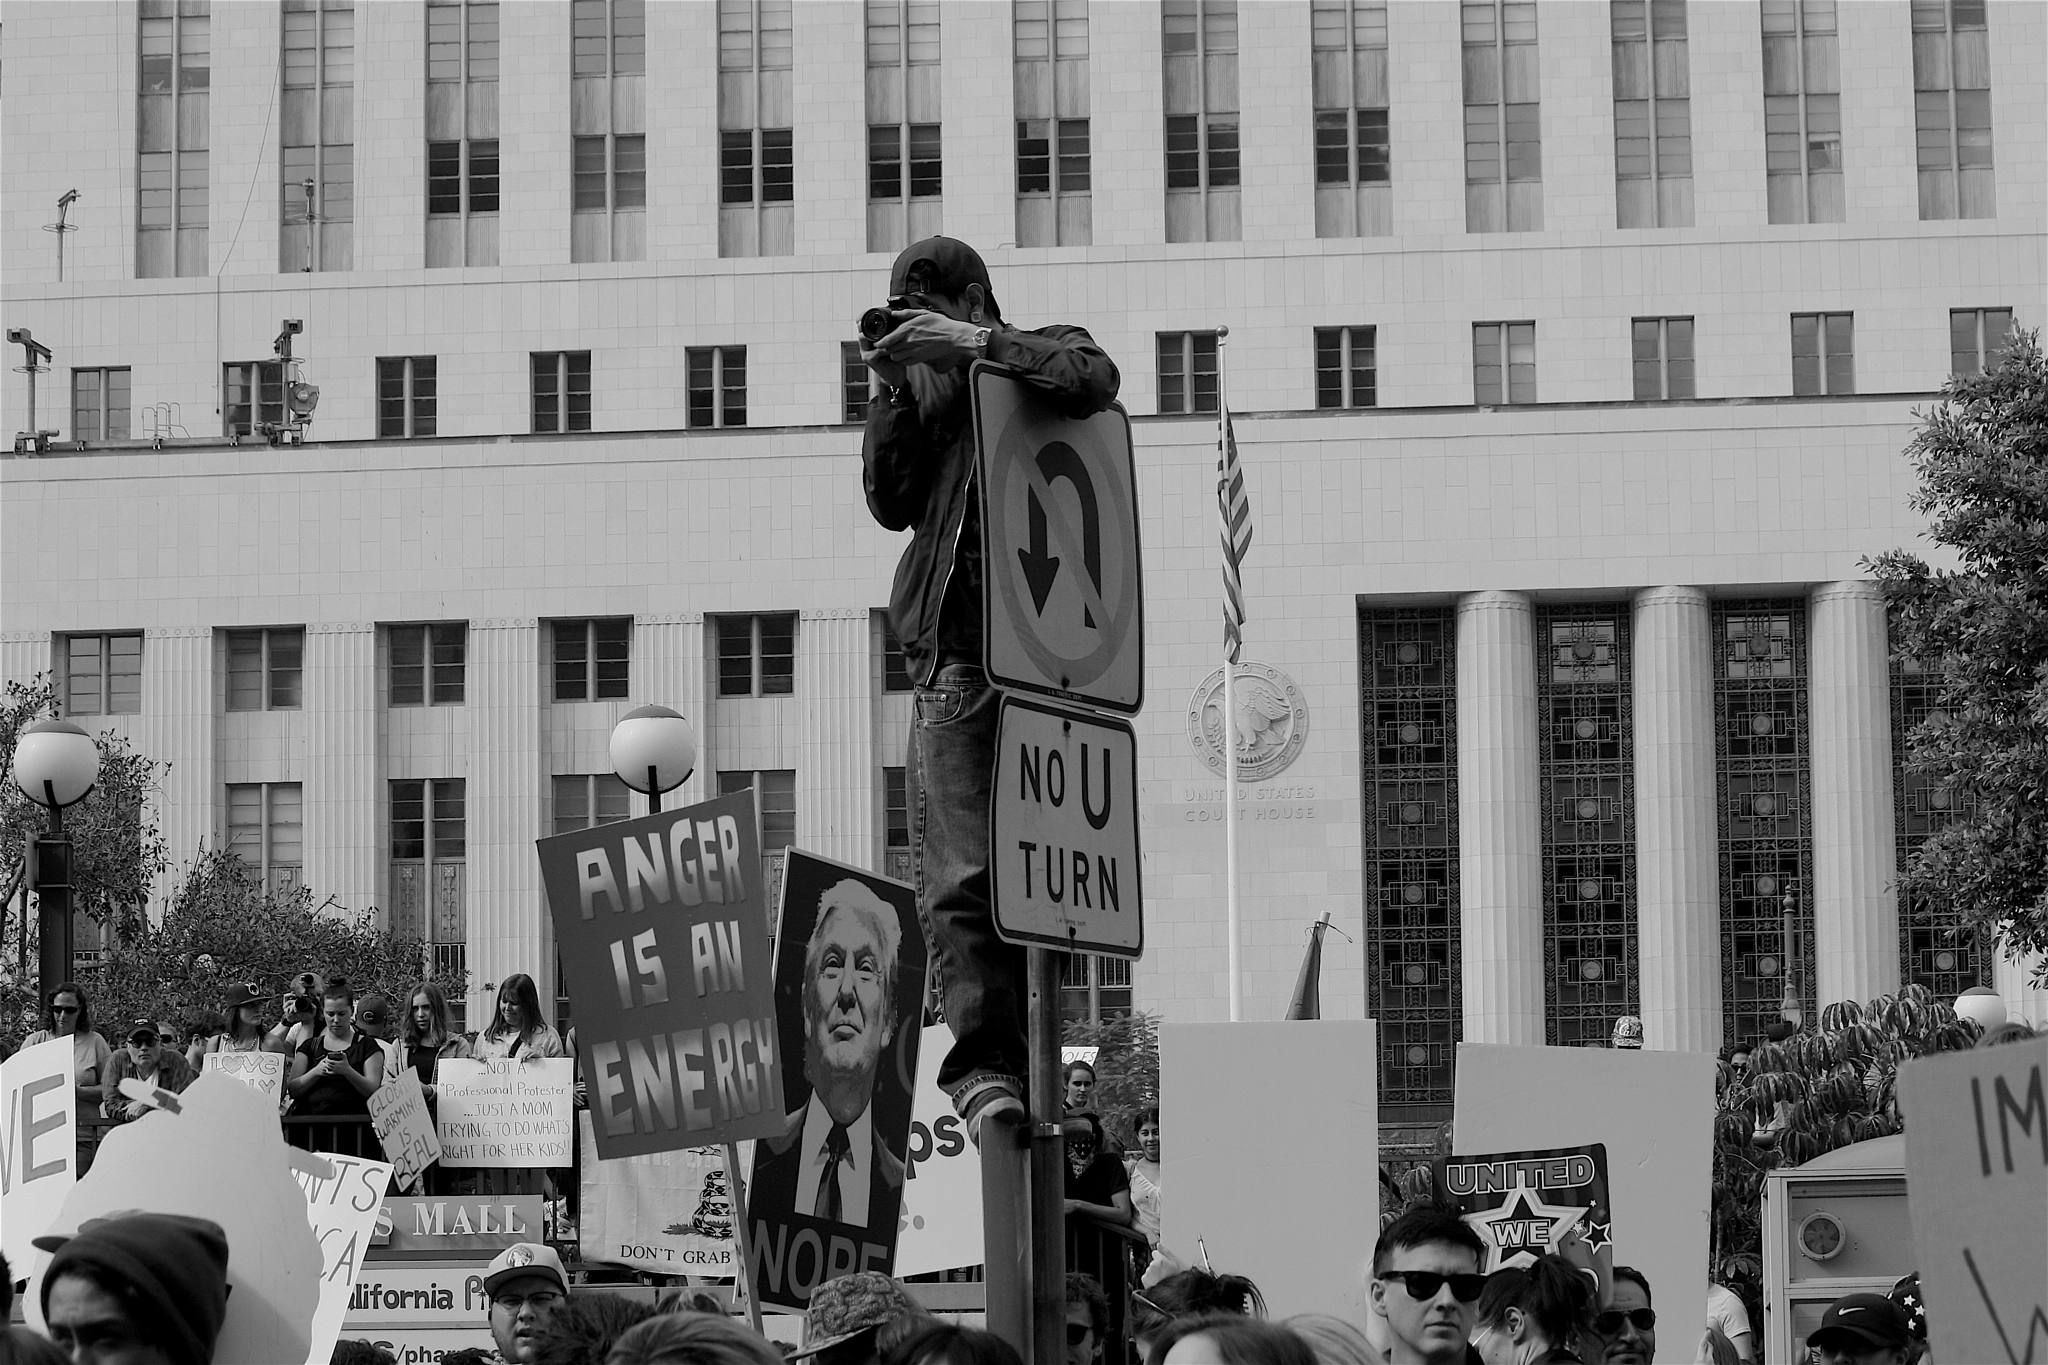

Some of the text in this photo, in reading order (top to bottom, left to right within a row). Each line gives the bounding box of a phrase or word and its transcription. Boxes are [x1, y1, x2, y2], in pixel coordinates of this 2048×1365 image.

[1021, 743, 1111, 830] NO U
[1184, 787, 1315, 801] UNITD STATES
[1184, 807, 1315, 822] COUT HOUSE
[576, 815, 747, 921] ANGER
[1019, 841, 1119, 912] TURN
[609, 920, 746, 1011] IS AN
[517, 1061, 527, 1075] A
[591, 1018, 775, 1138] ENERGY
[371, 1079, 416, 1118] GLOBAL
[510, 1102, 519, 1116] A
[522, 1101, 553, 1116] MOM
[378, 1094, 422, 1141] WARMING
[440, 1119, 570, 1138] TRYING TO DO WHAT'S
[398, 1126, 412, 1148] IS
[441, 1139, 570, 1160] RIGHT FOR HER KIDS!!
[394, 1133, 437, 1188] REAL
[1446, 1154, 1595, 1195] UNITED
[295, 1158, 385, 1212] NTS
[412, 1202, 526, 1236] MALL
[1490, 1218, 1551, 1248] WE
[620, 1244, 731, 1264] DON'T GRAB
